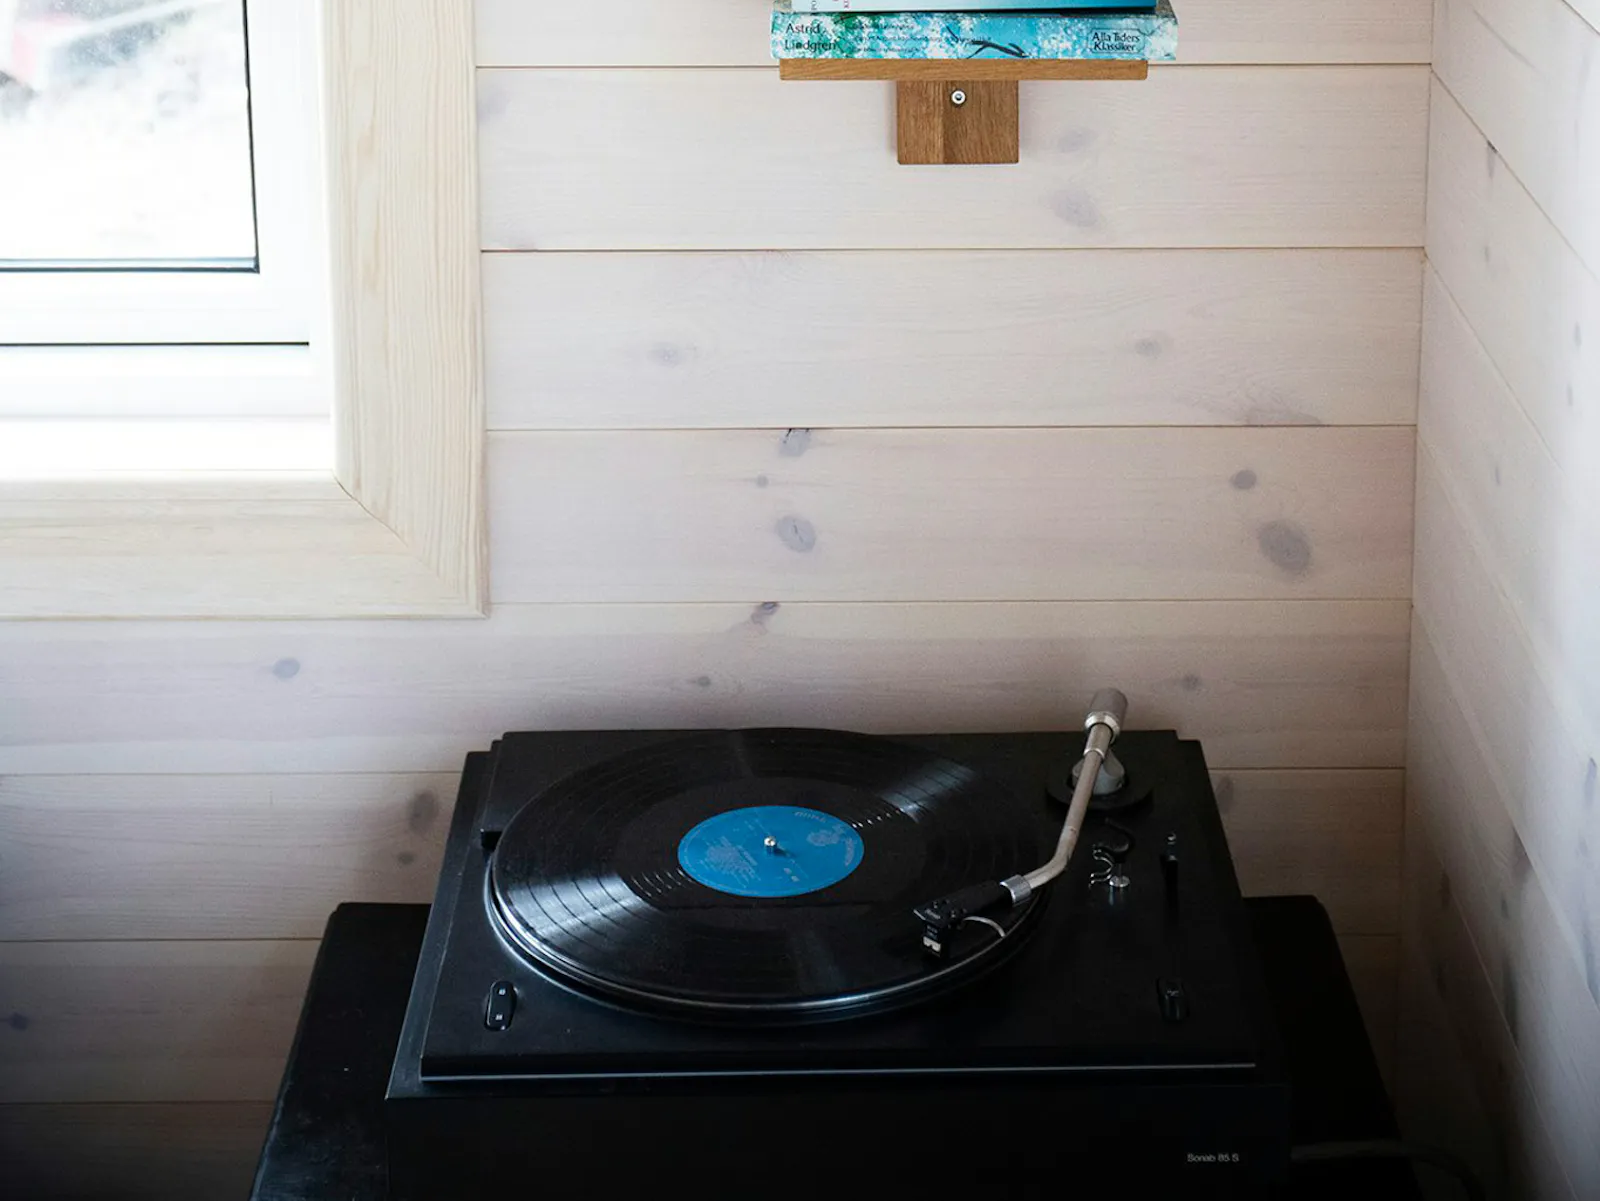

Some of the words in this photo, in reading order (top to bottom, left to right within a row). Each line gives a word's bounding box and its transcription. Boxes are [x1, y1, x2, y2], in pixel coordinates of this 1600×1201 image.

[786, 23, 821, 34] Astrid
[1093, 32, 1111, 41] Alla
[1112, 32, 1140, 41] Tiders
[785, 39, 837, 52] Lindgren
[1094, 42, 1135, 51] Klassiker
